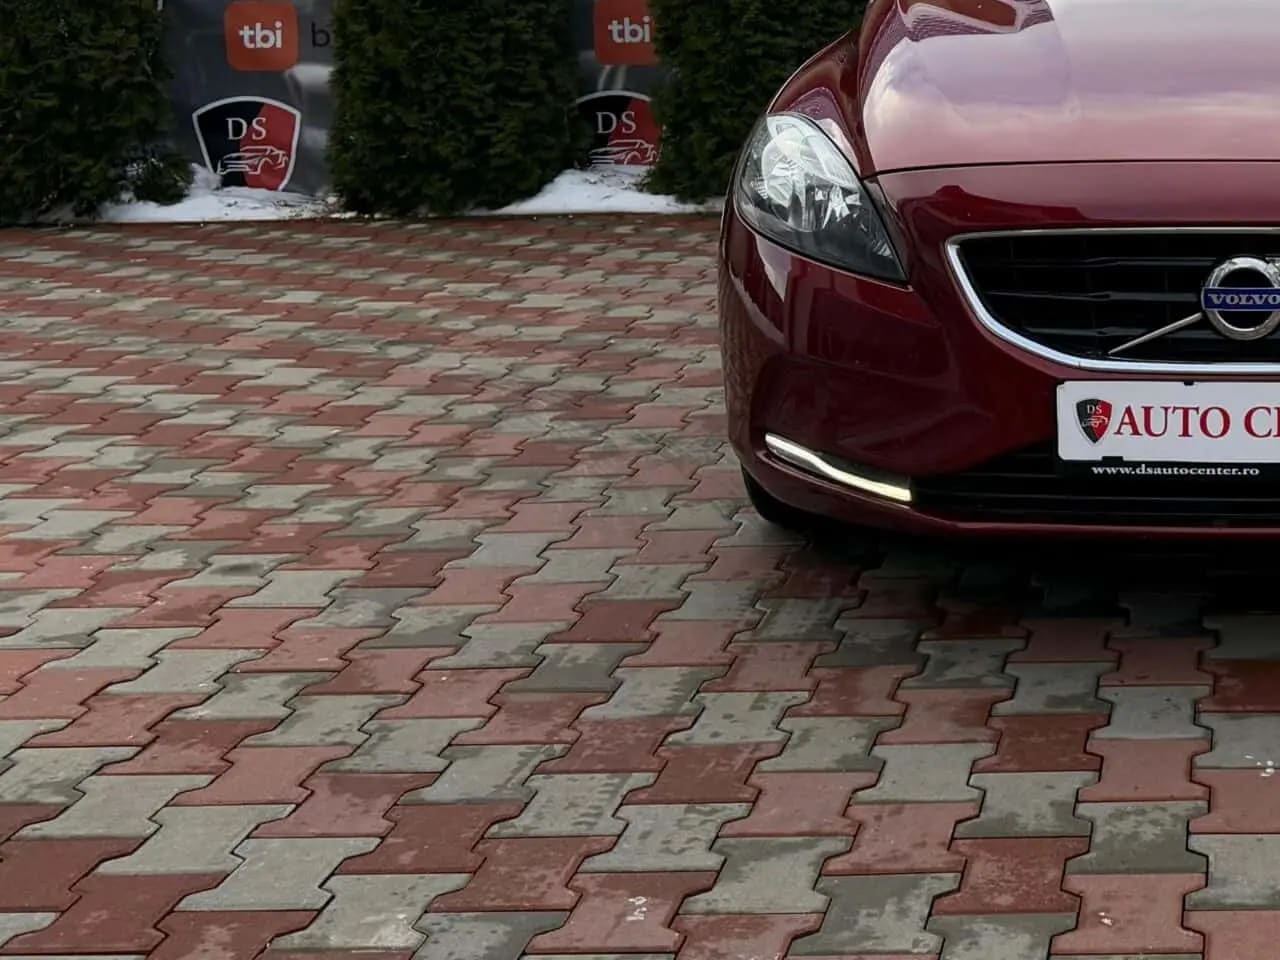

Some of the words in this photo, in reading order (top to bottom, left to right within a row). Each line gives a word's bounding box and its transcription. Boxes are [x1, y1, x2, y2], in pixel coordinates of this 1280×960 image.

[238, 20, 283, 49] tbi
[607, 15, 651, 43] tbi
[225, 116, 267, 140] DS
[595, 110, 637, 134] DS
[1113, 405, 1231, 438] AUTO
[1091, 464, 1260, 476] www.dsautocenter.ro
